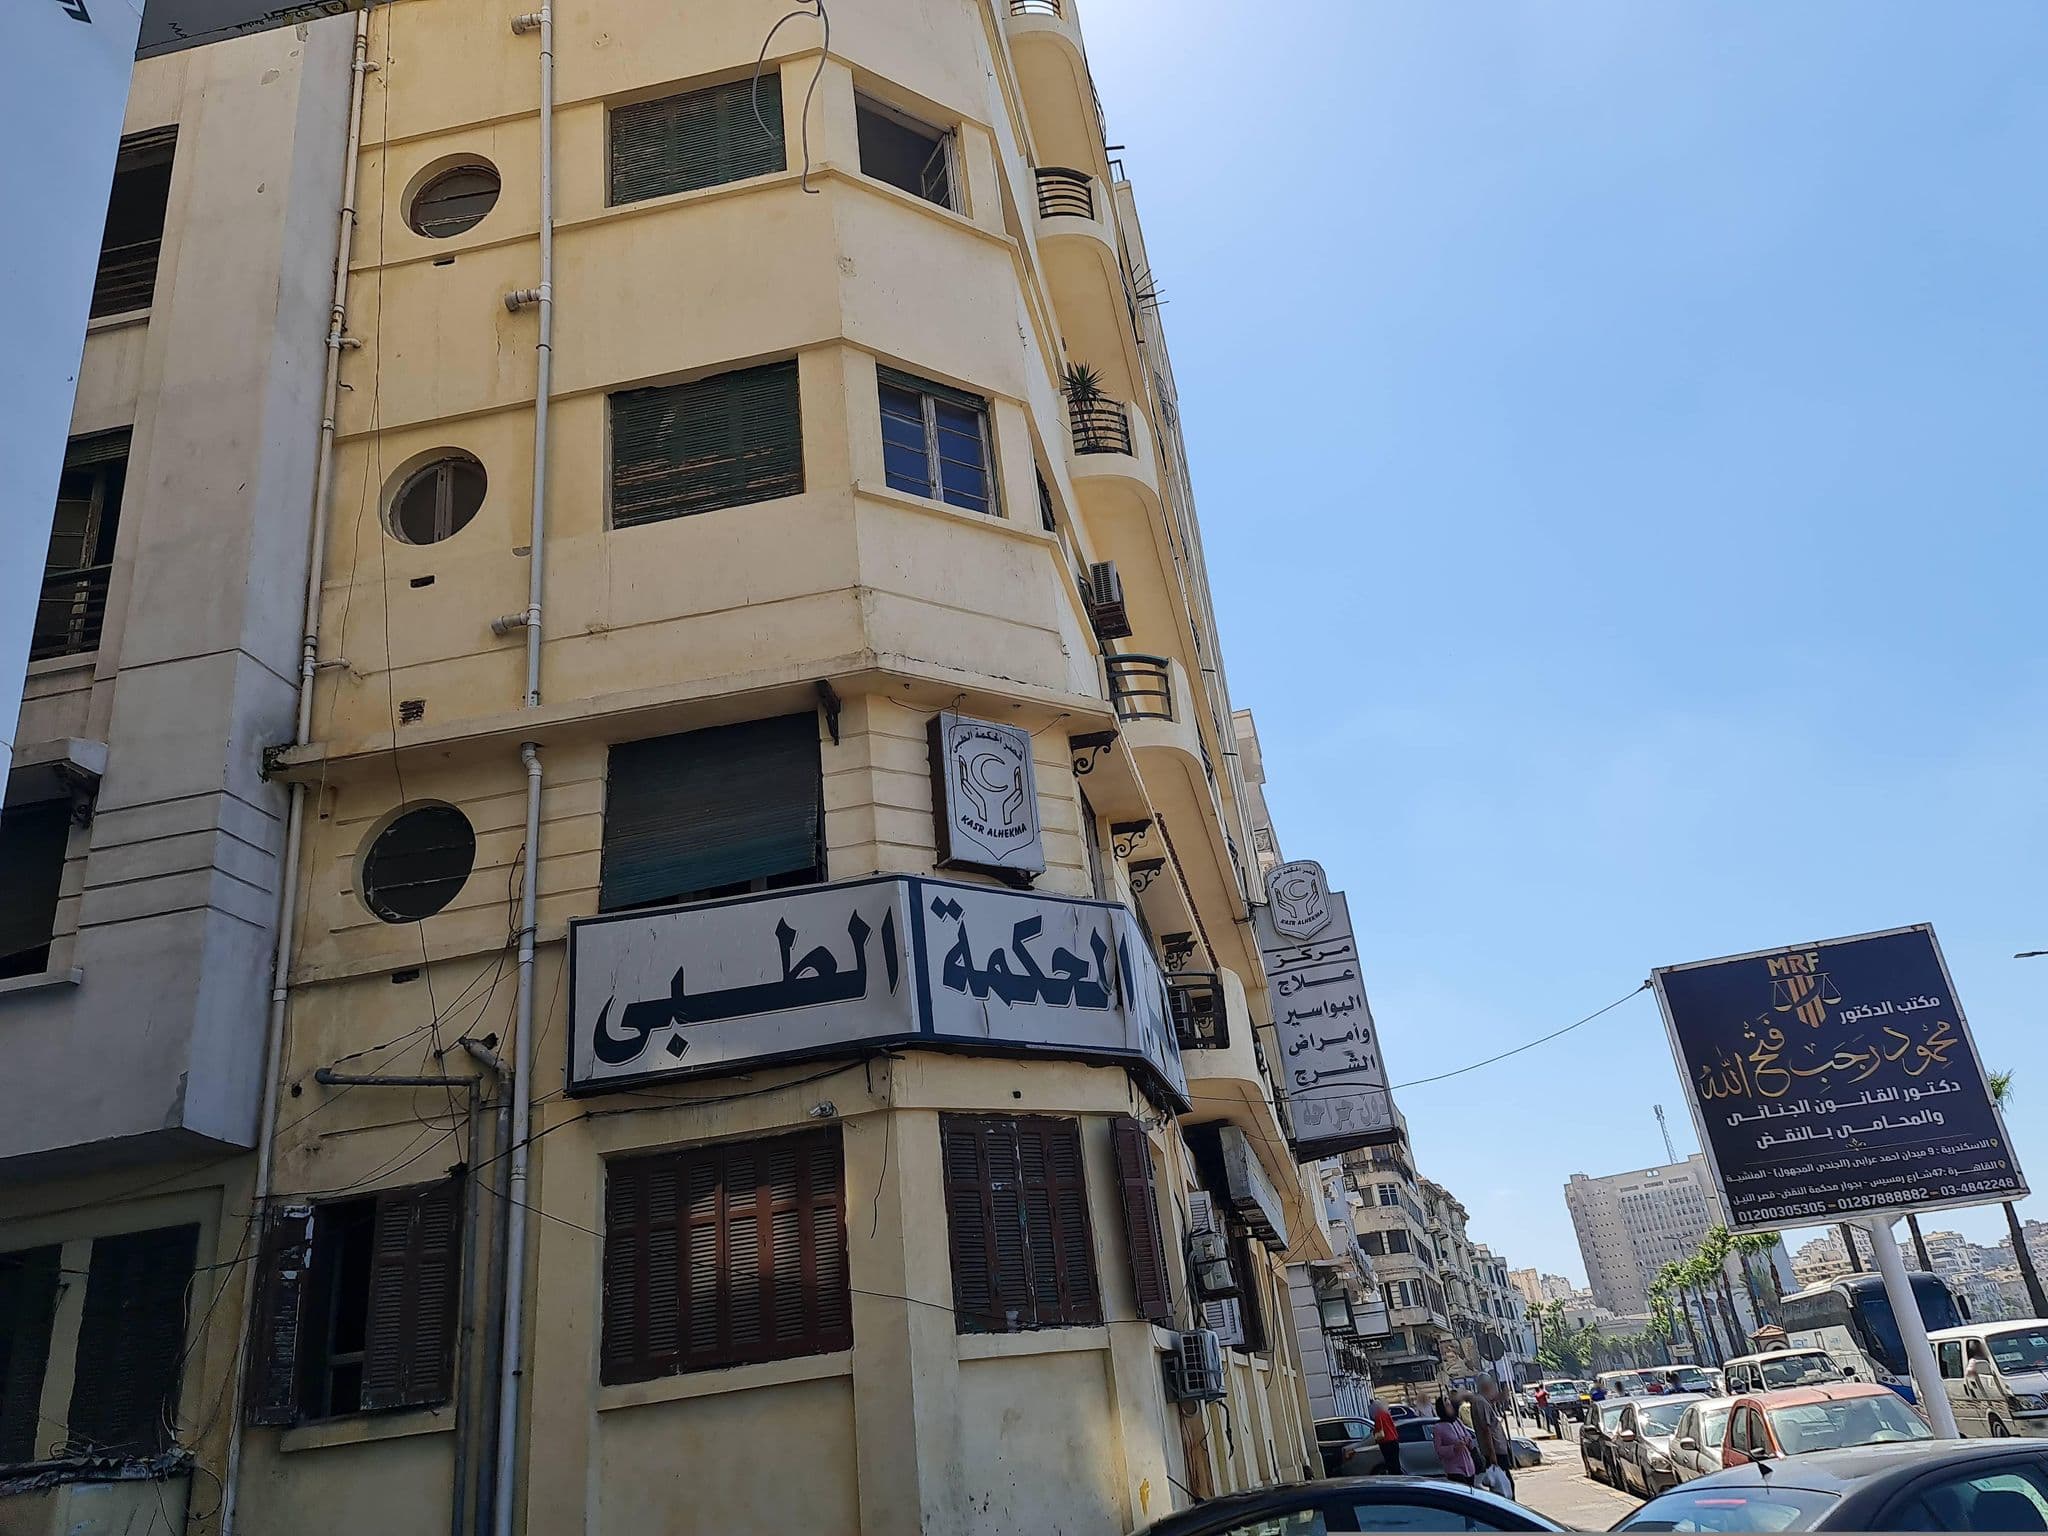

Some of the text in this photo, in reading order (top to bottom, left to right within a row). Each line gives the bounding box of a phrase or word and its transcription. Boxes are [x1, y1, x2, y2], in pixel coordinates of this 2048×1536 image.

[960, 814, 1028, 838] KASR ALHEKMA
[929, 896, 1136, 1016] الحكمة
[1273, 945, 1351, 968] مركز
[1766, 952, 1819, 978] MRF
[1277, 969, 1355, 996] علاج
[1282, 994, 1362, 1027] البواسير
[1840, 995, 1941, 1025] مكتب الدكتور
[1814, 1086, 1899, 1115] القانون
[1903, 1079, 1962, 1102] دكتور
[1755, 1126, 1834, 1150] بالنقض
[1901, 1150, 1927, 1161] ميدان
[1927, 1147, 1935, 1156] 9
[1808, 1184, 1839, 1194] محكمة
[1840, 1181, 1862, 1192] بجوار
[1870, 1175, 1905, 1187] رمسيس
[1738, 1201, 1827, 1222] 01200305305
[1837, 1188, 1929, 1210] 01287888882
[1940, 1177, 2015, 1197] 03-4842248
